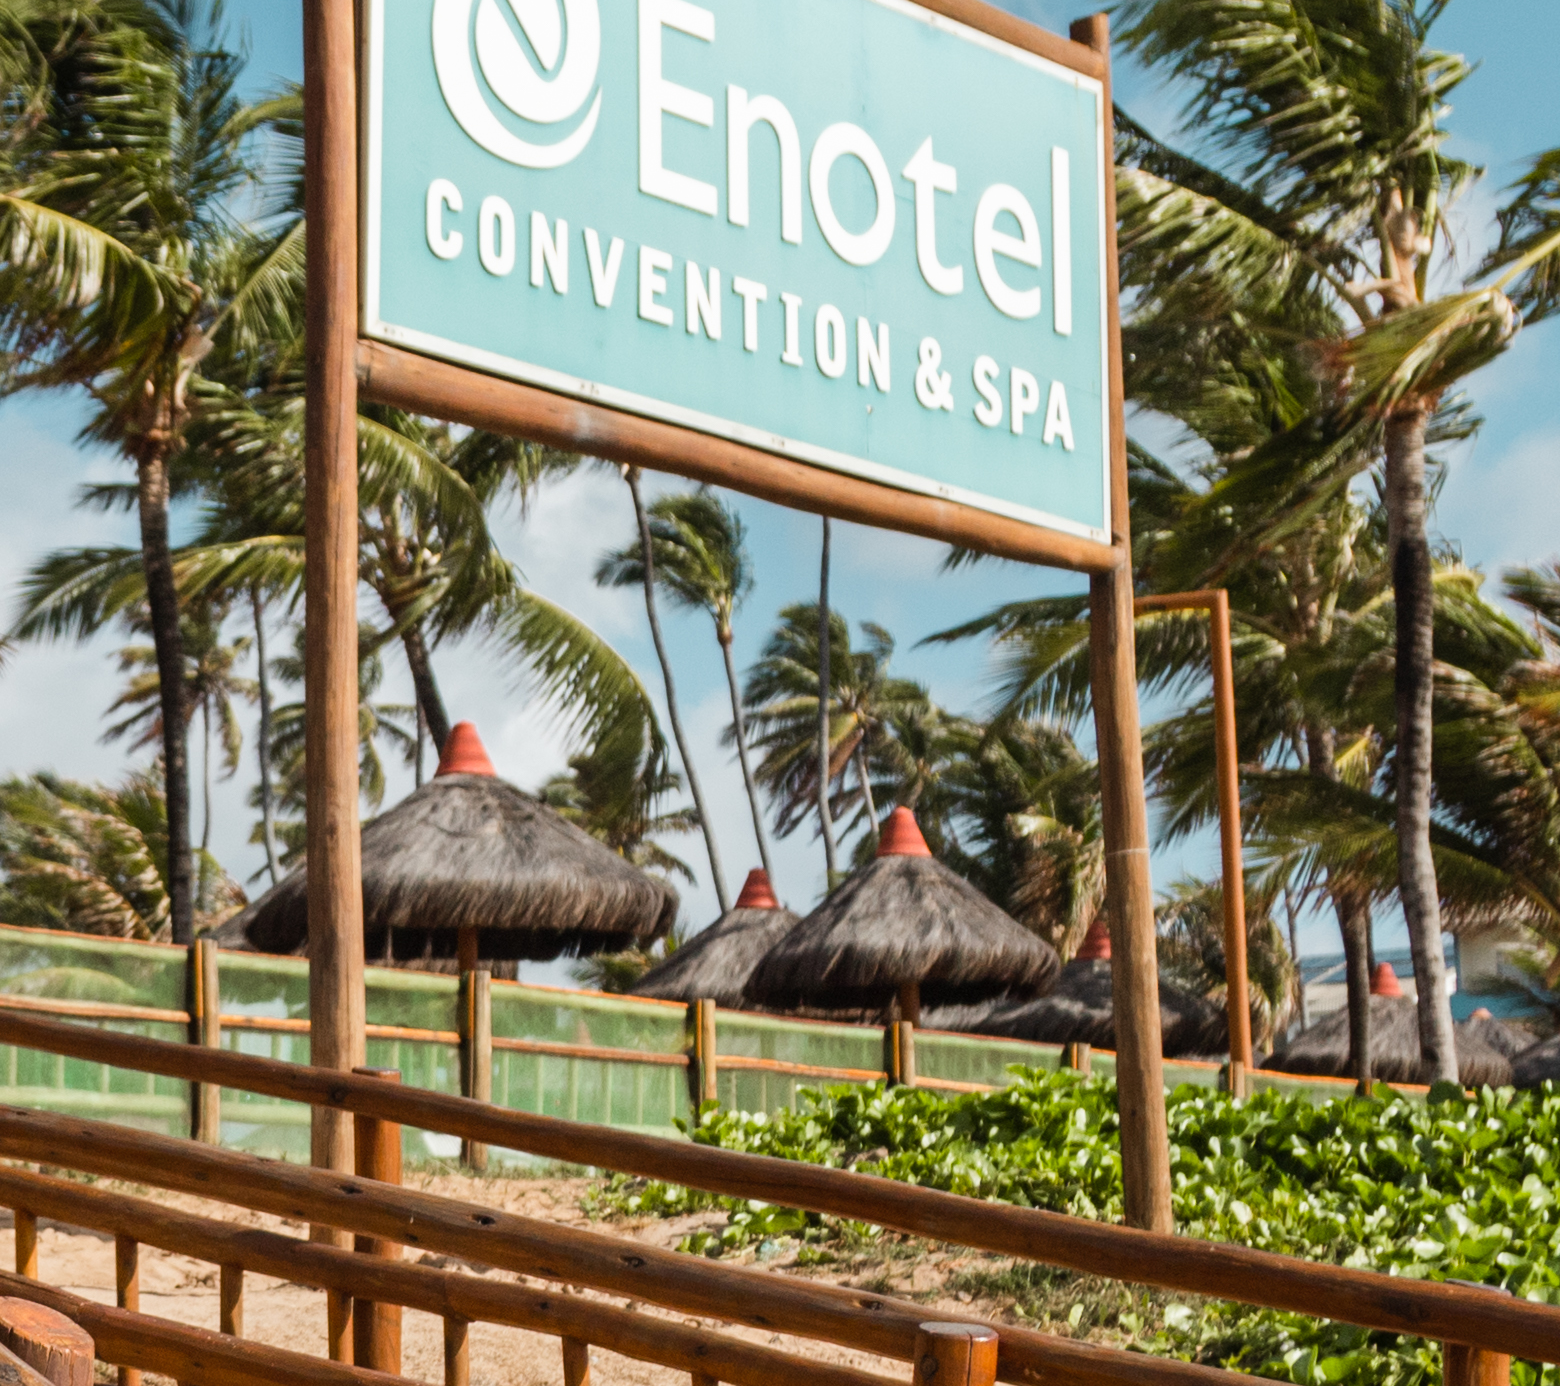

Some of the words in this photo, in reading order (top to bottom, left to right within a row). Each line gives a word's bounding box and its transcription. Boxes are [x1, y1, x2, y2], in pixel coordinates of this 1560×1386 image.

[425, 177, 892, 393] CONVENTION
[914, 335, 955, 412] &
[972, 354, 1076, 452] SPA
